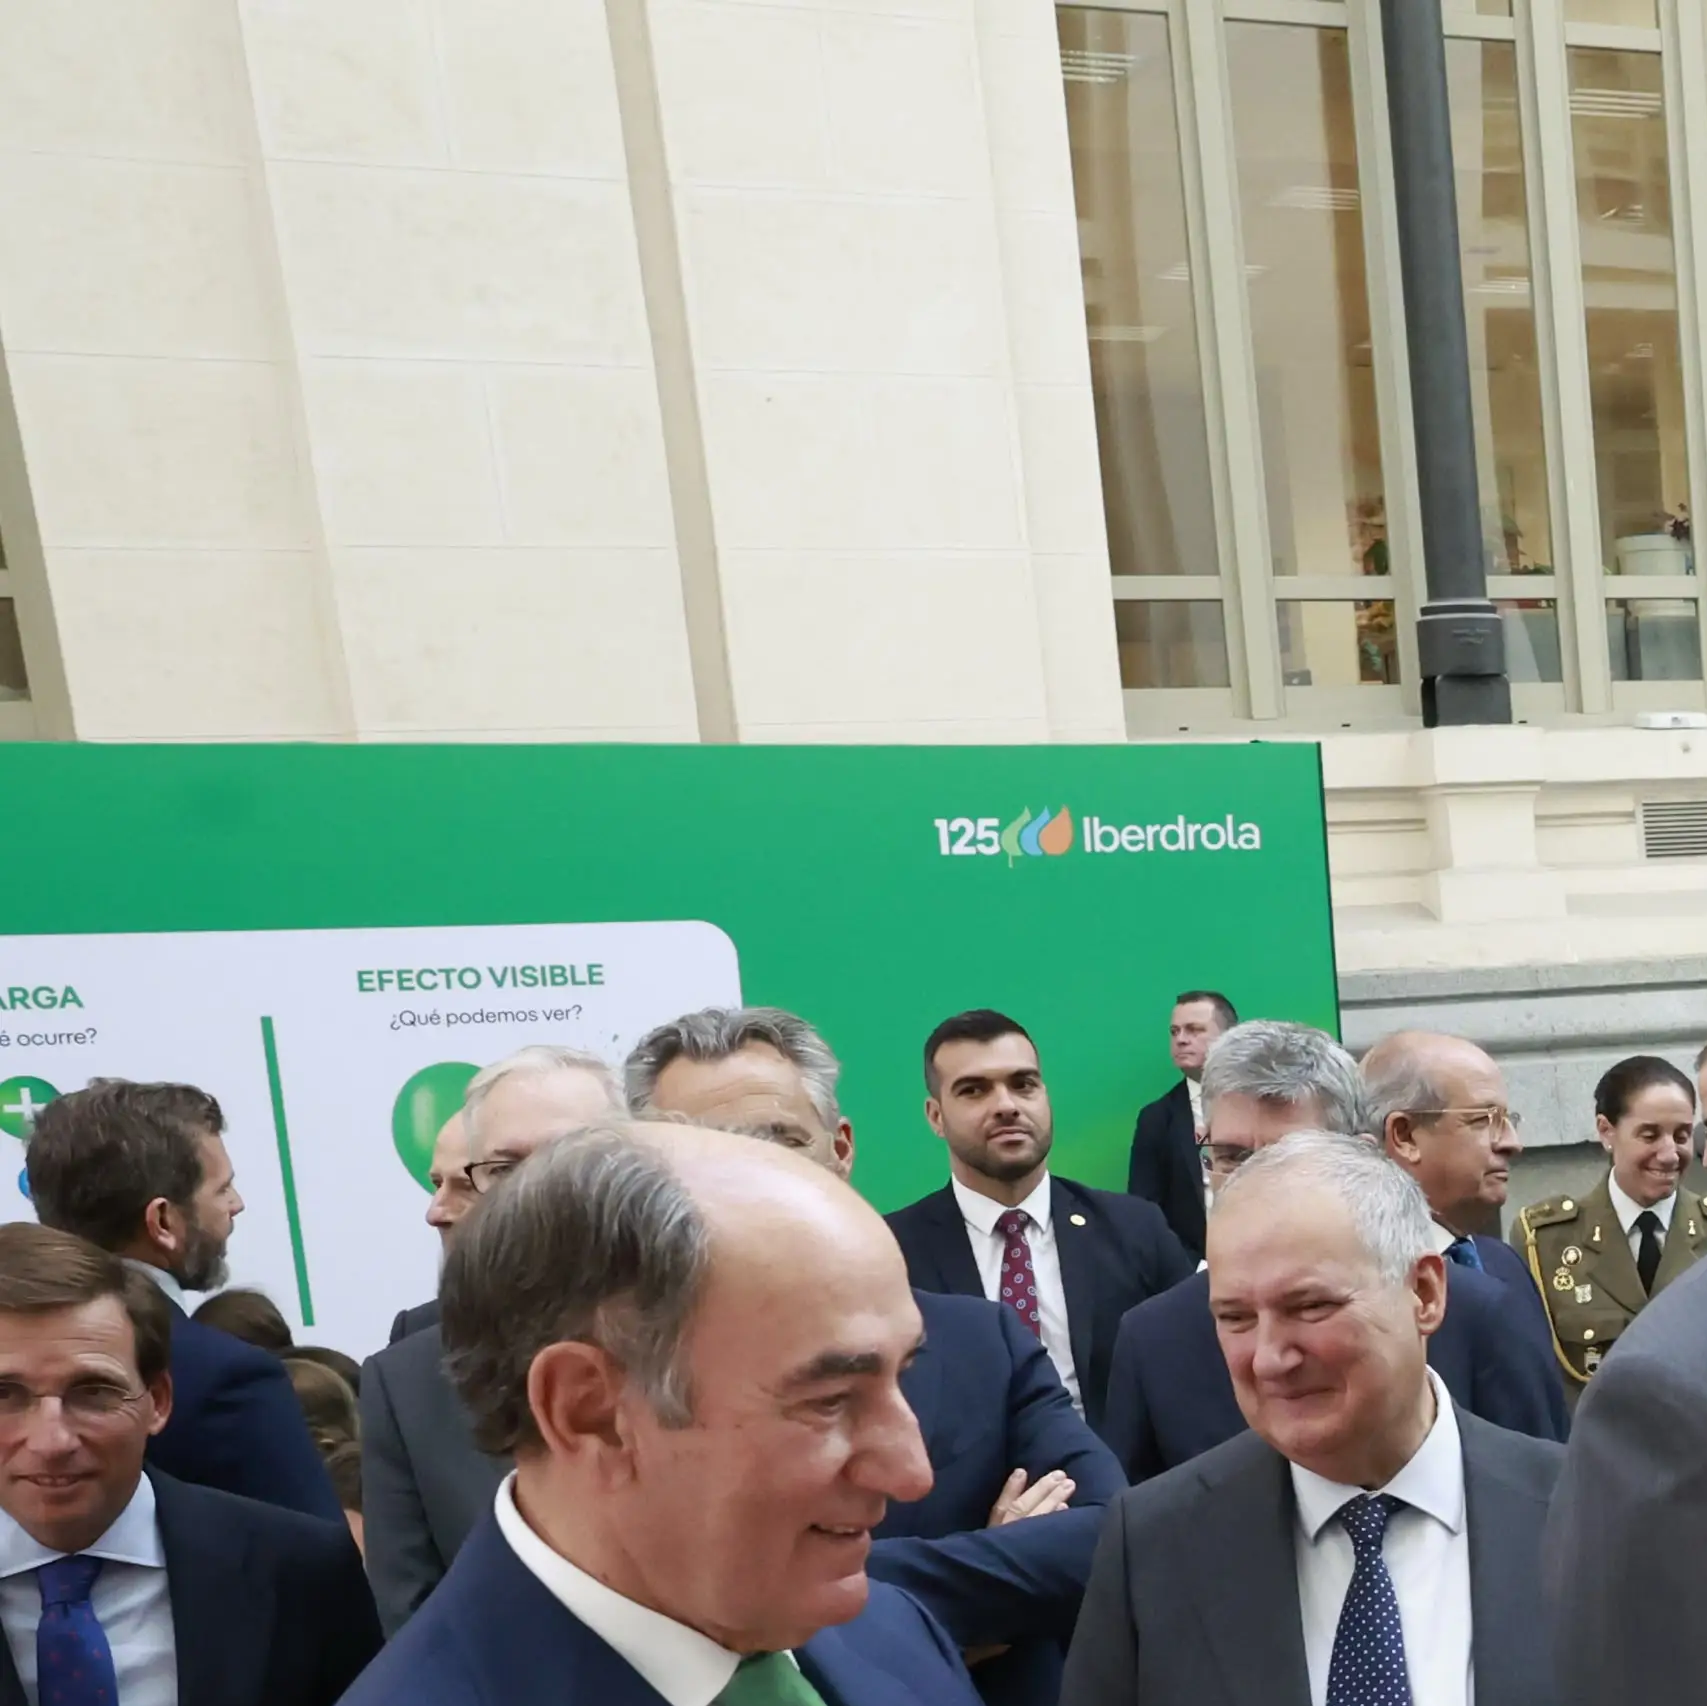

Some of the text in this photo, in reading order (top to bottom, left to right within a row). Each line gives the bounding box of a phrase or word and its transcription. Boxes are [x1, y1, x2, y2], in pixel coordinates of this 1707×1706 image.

[934, 814, 1261, 856] 125 Iberdrola
[357, 963, 605, 993] EFECTO VISIBLE
[390, 1004, 583, 1031] ¿Qué podemos ver?
[17, 1028, 98, 1047] ocurre?
